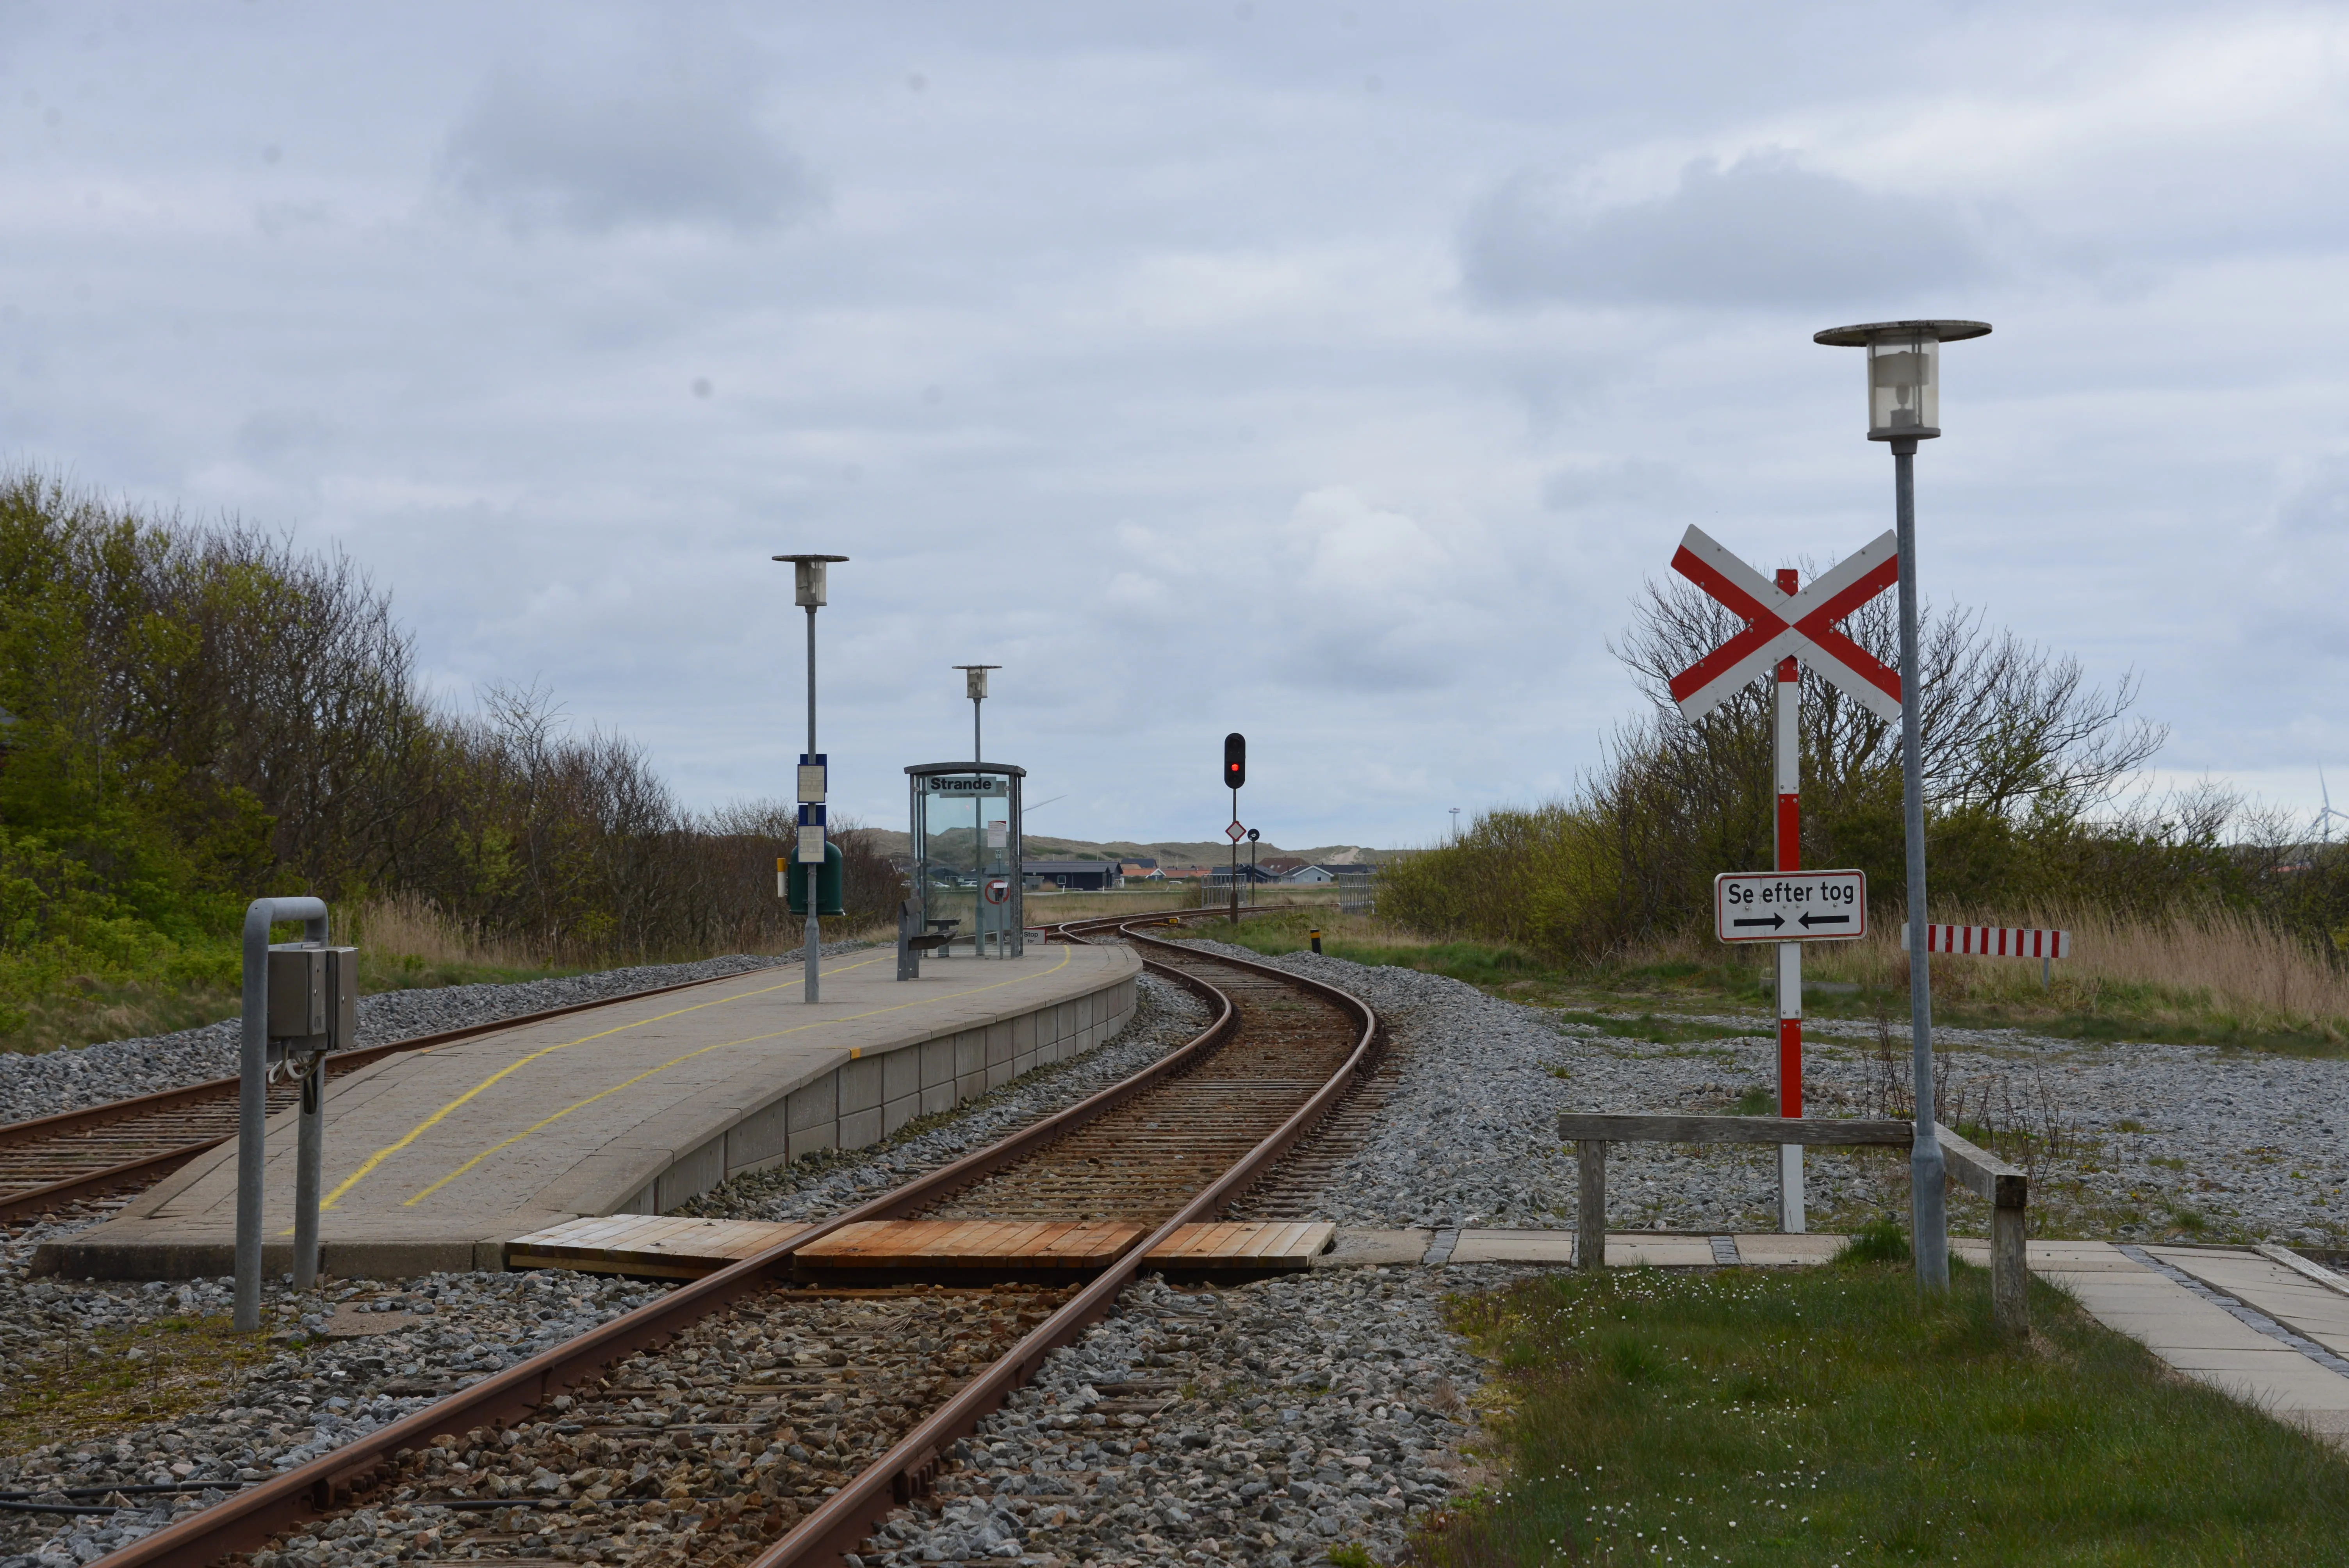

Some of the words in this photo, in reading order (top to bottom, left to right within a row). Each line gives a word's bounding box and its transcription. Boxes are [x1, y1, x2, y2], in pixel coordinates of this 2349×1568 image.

[931, 777, 992, 790] Strande
[1729, 884, 1754, 904] Se
[1762, 882, 1813, 903] efter
[1820, 881, 1854, 904] tog
